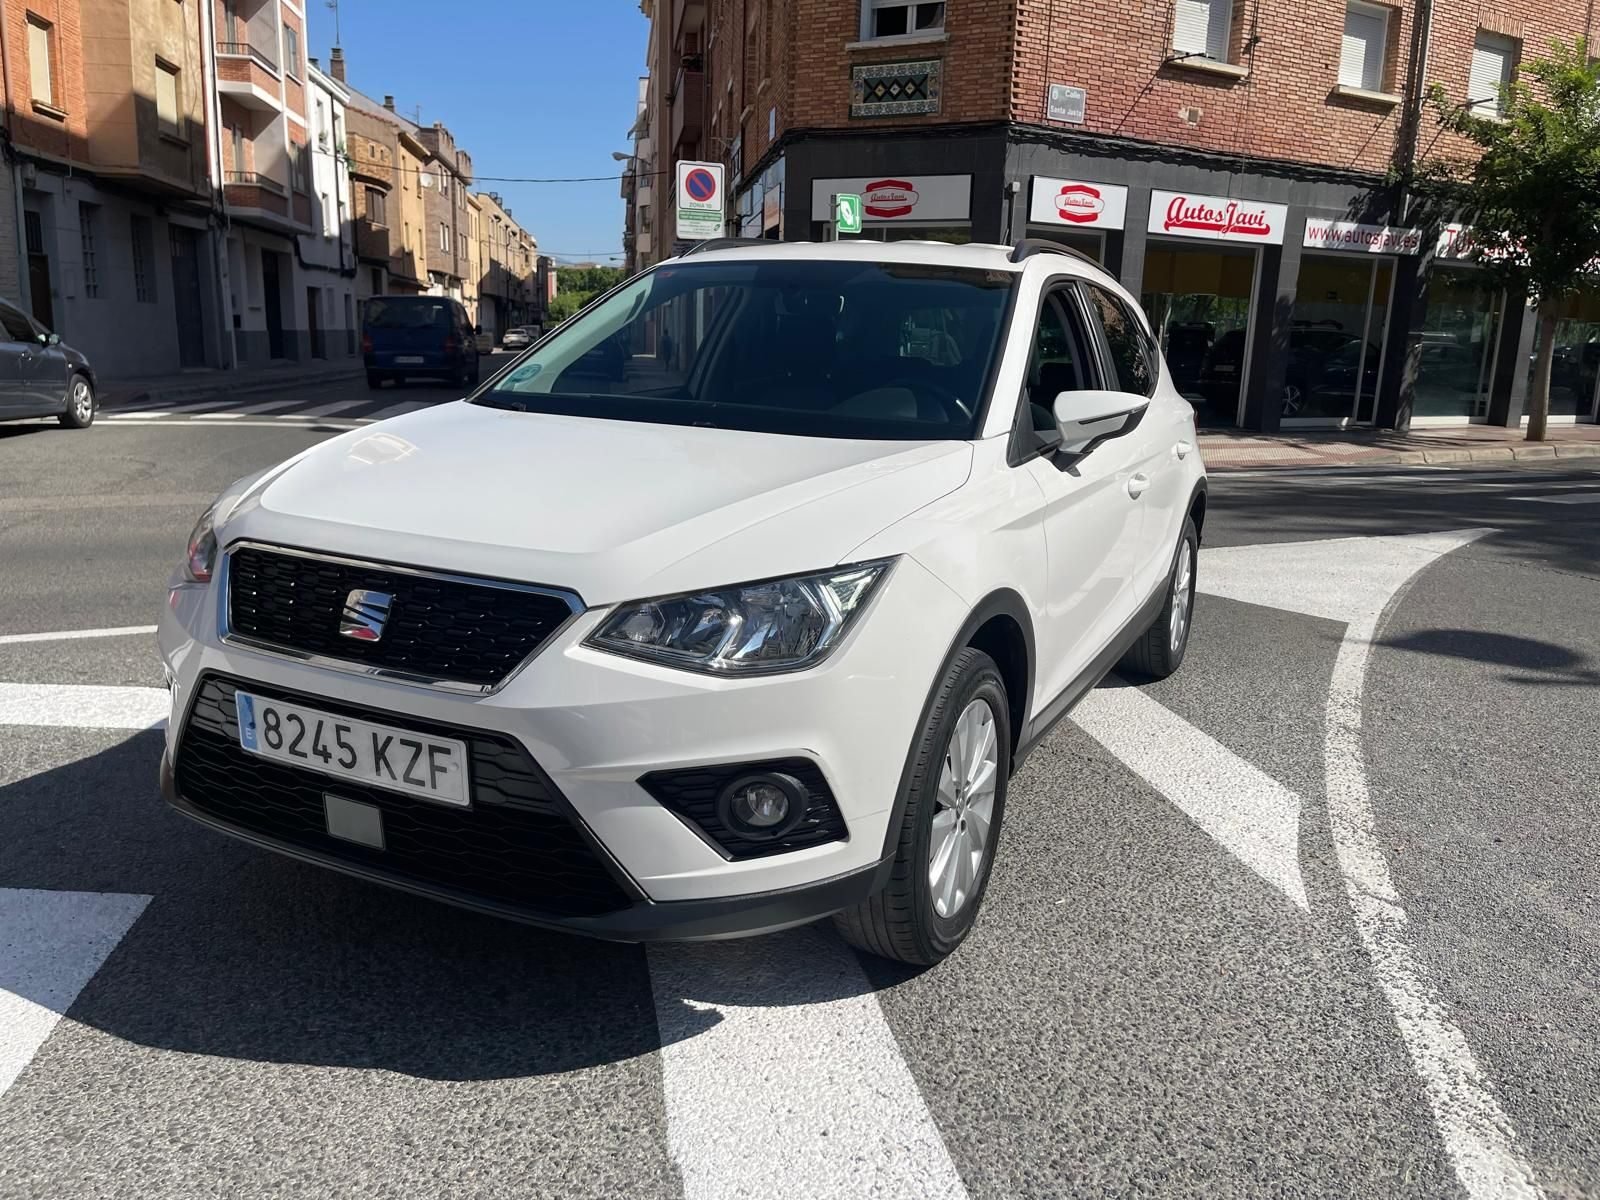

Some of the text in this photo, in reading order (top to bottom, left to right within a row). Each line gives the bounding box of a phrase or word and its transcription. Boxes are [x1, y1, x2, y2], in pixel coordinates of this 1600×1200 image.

[1308, 225, 1418, 249] www.autosjavi.es
[262, 707, 452, 790] 8245 KZF
